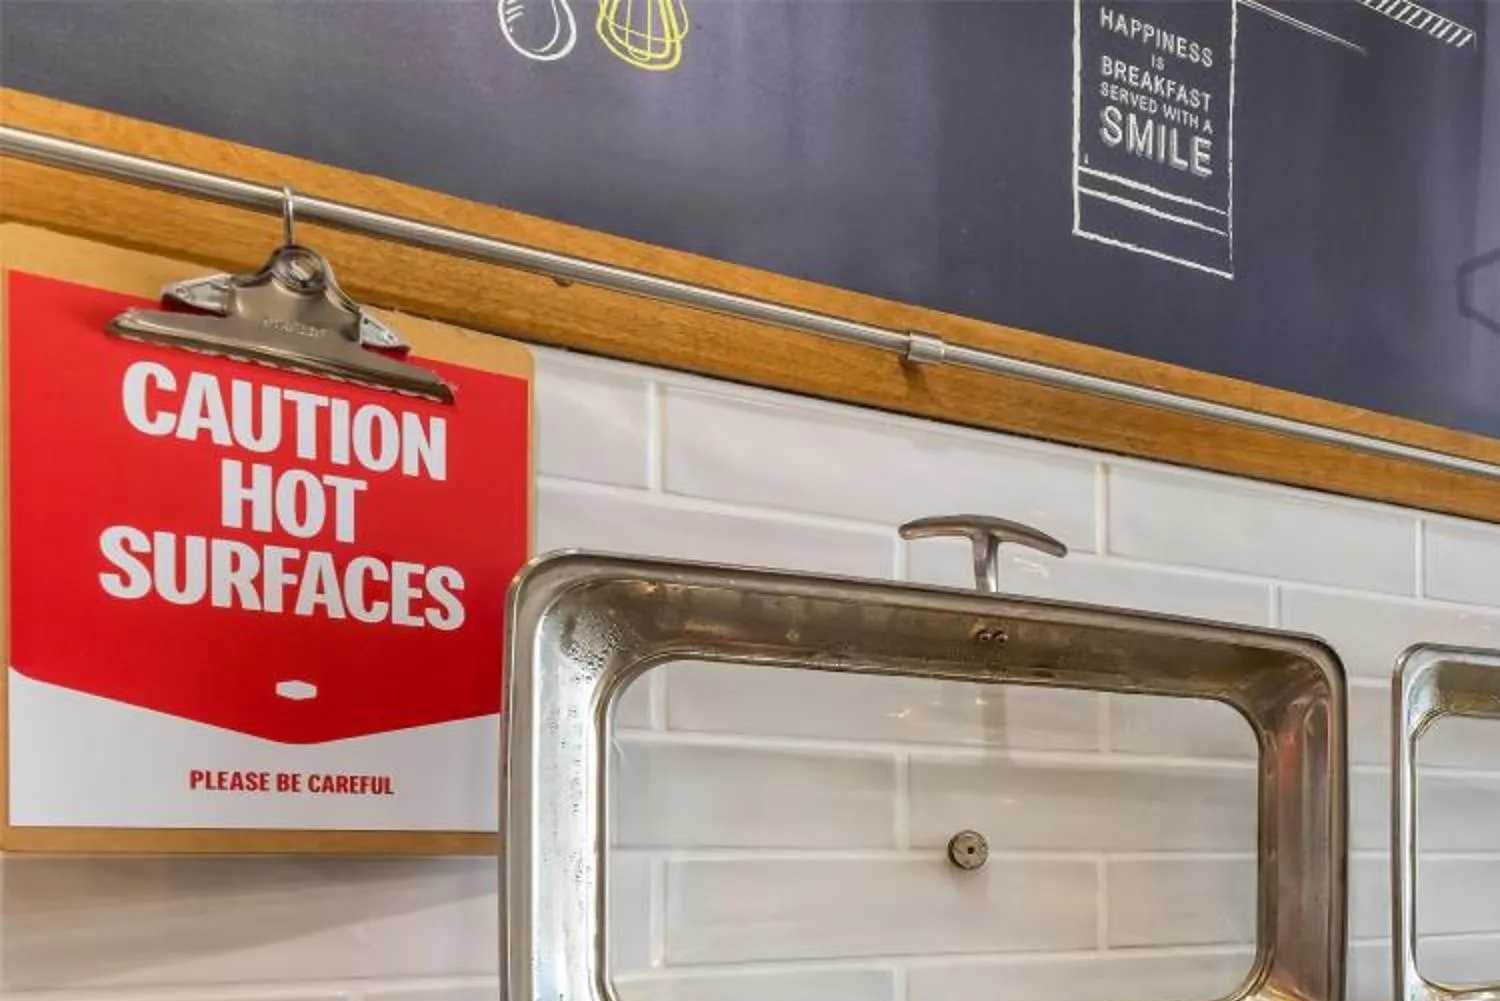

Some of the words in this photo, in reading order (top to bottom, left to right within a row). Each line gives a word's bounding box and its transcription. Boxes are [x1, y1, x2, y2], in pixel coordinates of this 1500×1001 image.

[1100, 6, 1214, 68] HAPPINESS
[1151, 53, 1165, 71] IS
[1100, 81, 1158, 114] SERVED
[1163, 103, 1199, 129] WITH
[1202, 119, 1214, 135] A
[1101, 55, 1212, 112] BREAKFAST
[1101, 105, 1213, 178] SMILE
[122, 360, 447, 482] CAUTION
[220, 458, 368, 543] HOT
[99, 525, 466, 632] SURFACES
[190, 769, 270, 792] PLEASE
[275, 773, 301, 793] BE
[307, 773, 394, 795] CAREFUL
